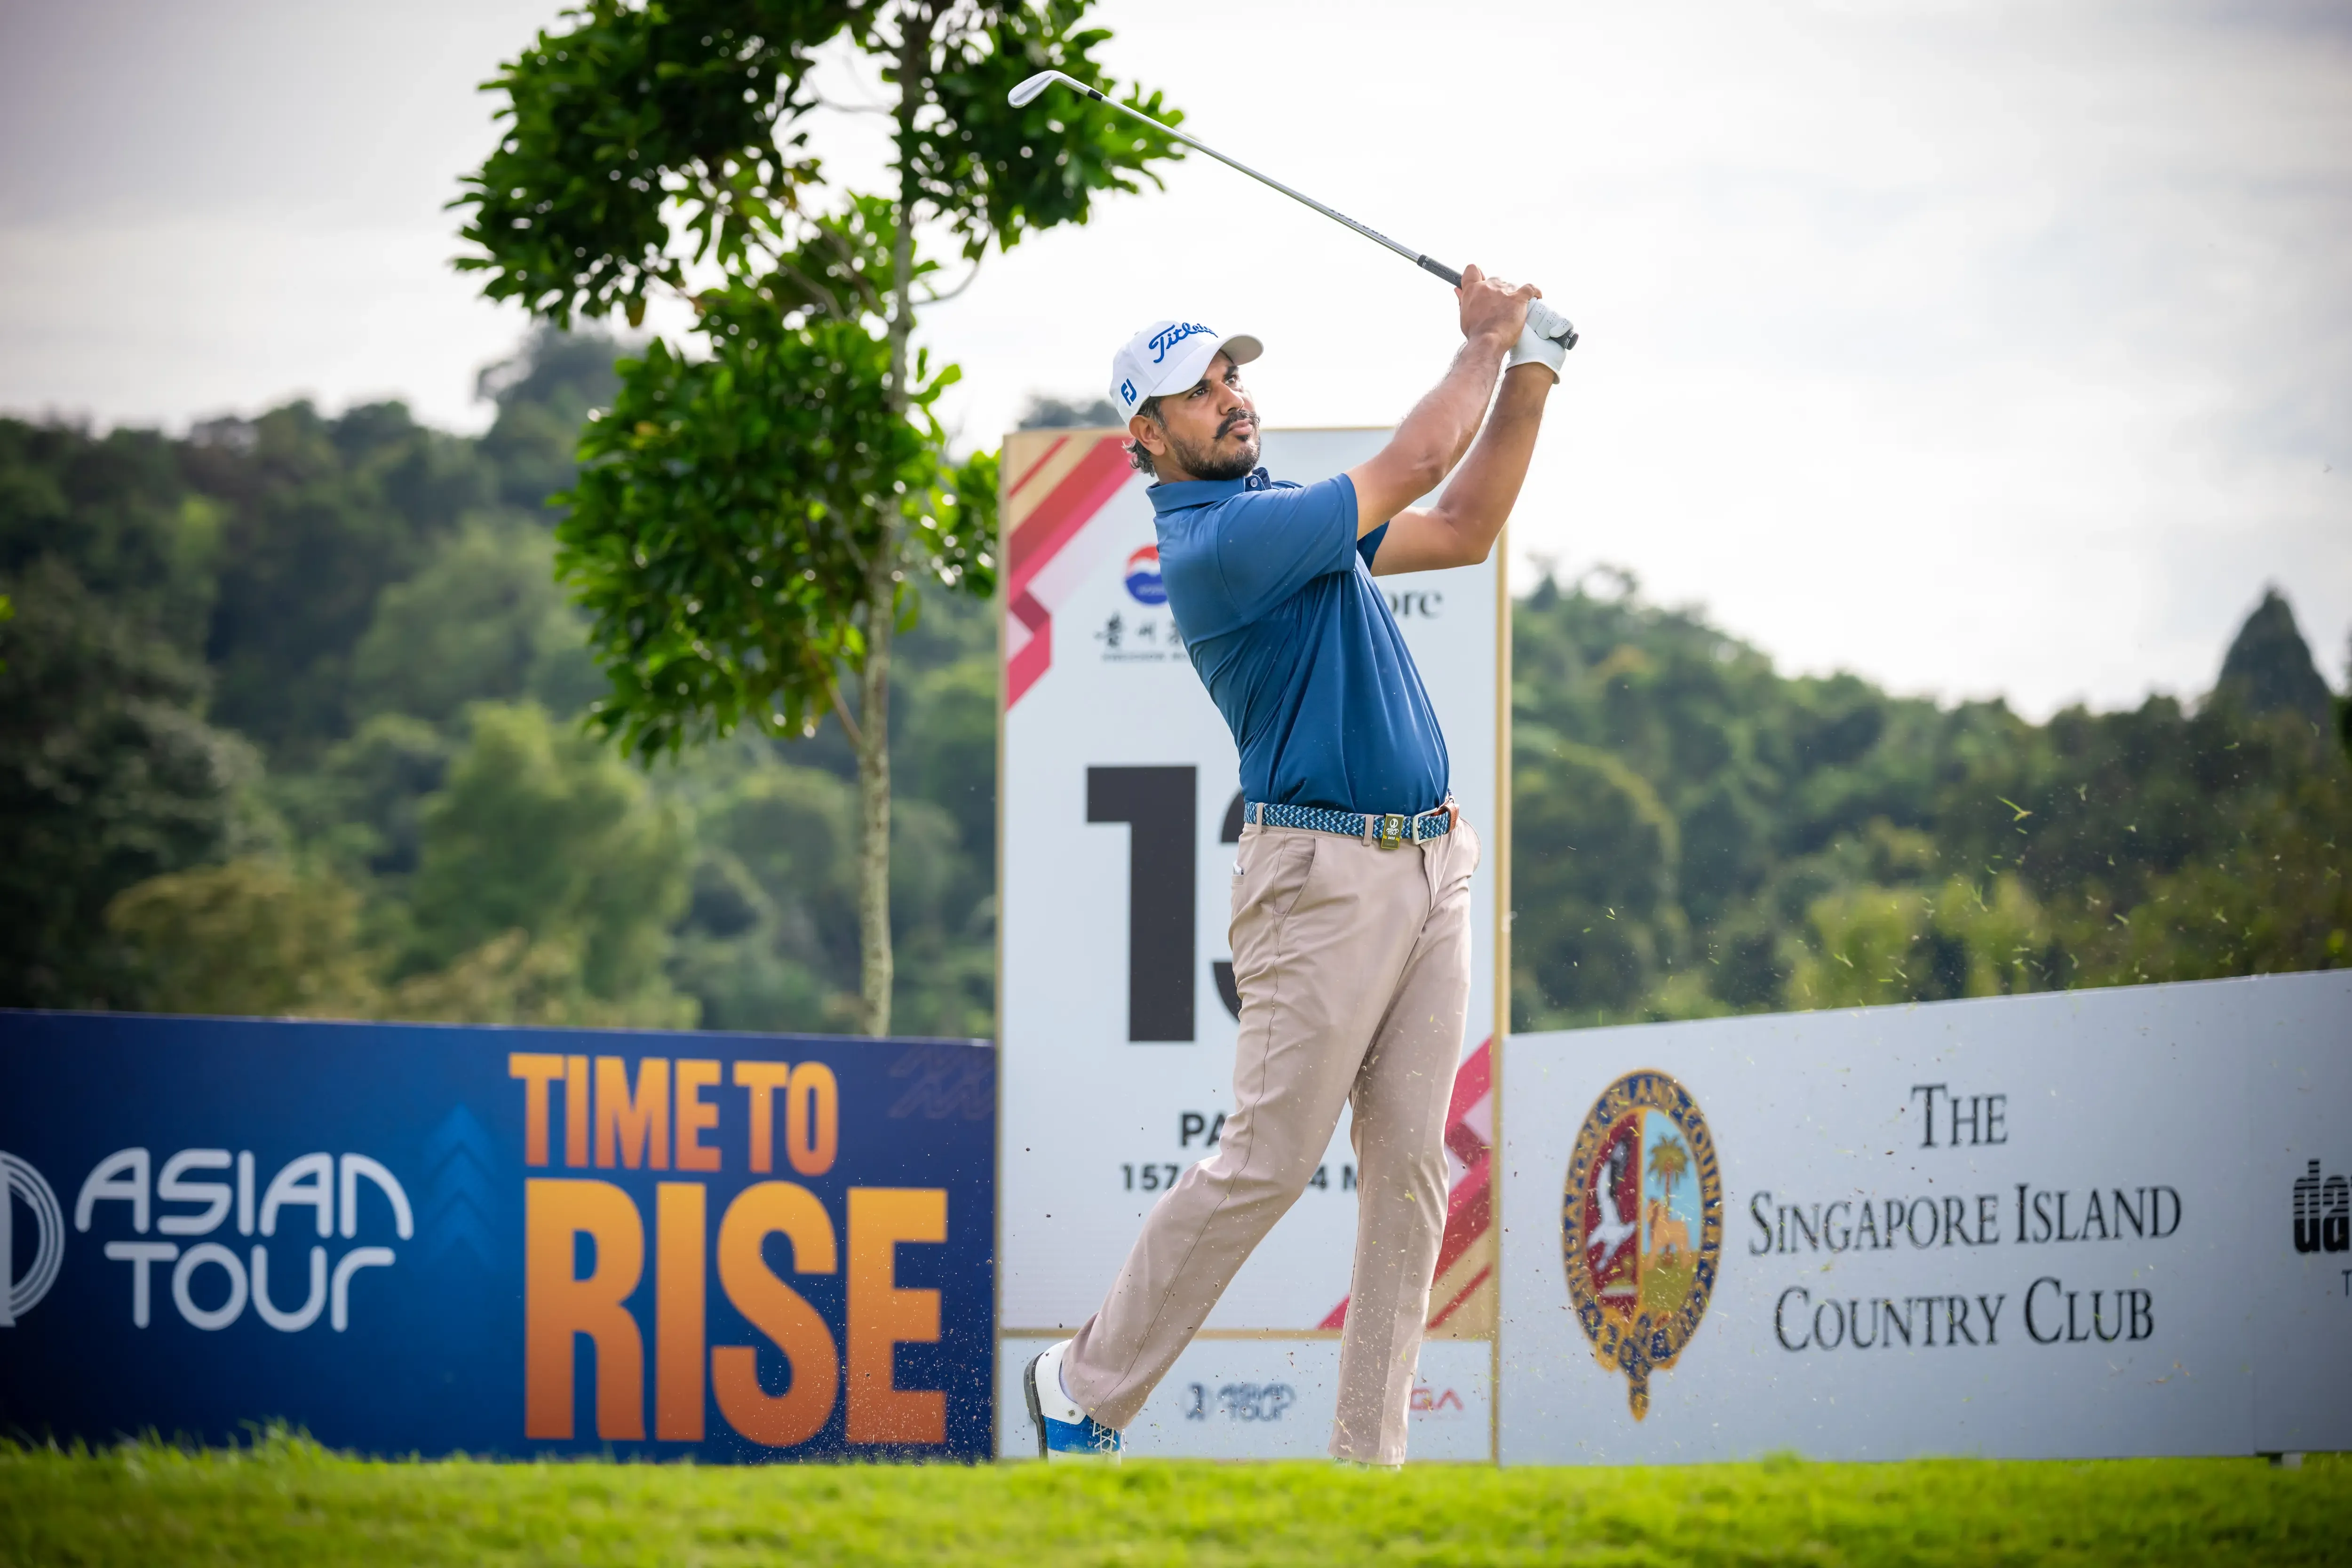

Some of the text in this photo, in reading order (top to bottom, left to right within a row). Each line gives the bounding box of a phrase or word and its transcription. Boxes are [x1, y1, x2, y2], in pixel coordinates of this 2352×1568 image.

[508, 1052, 839, 1176] TIME TO
[1180, 1112, 1227, 1147] PA
[1910, 1082, 2008, 1148] THE
[74, 1146, 414, 1240] ASIAN
[1122, 1163, 1181, 1193] 157
[1748, 1183, 2183, 1256] SINGAPORE ISLAND
[2293, 1158, 2352, 1253] da
[103, 1242, 396, 1333] TOUR
[524, 1178, 948, 1448] RISE
[1773, 1276, 2155, 1352] COUNTRY CLUB
